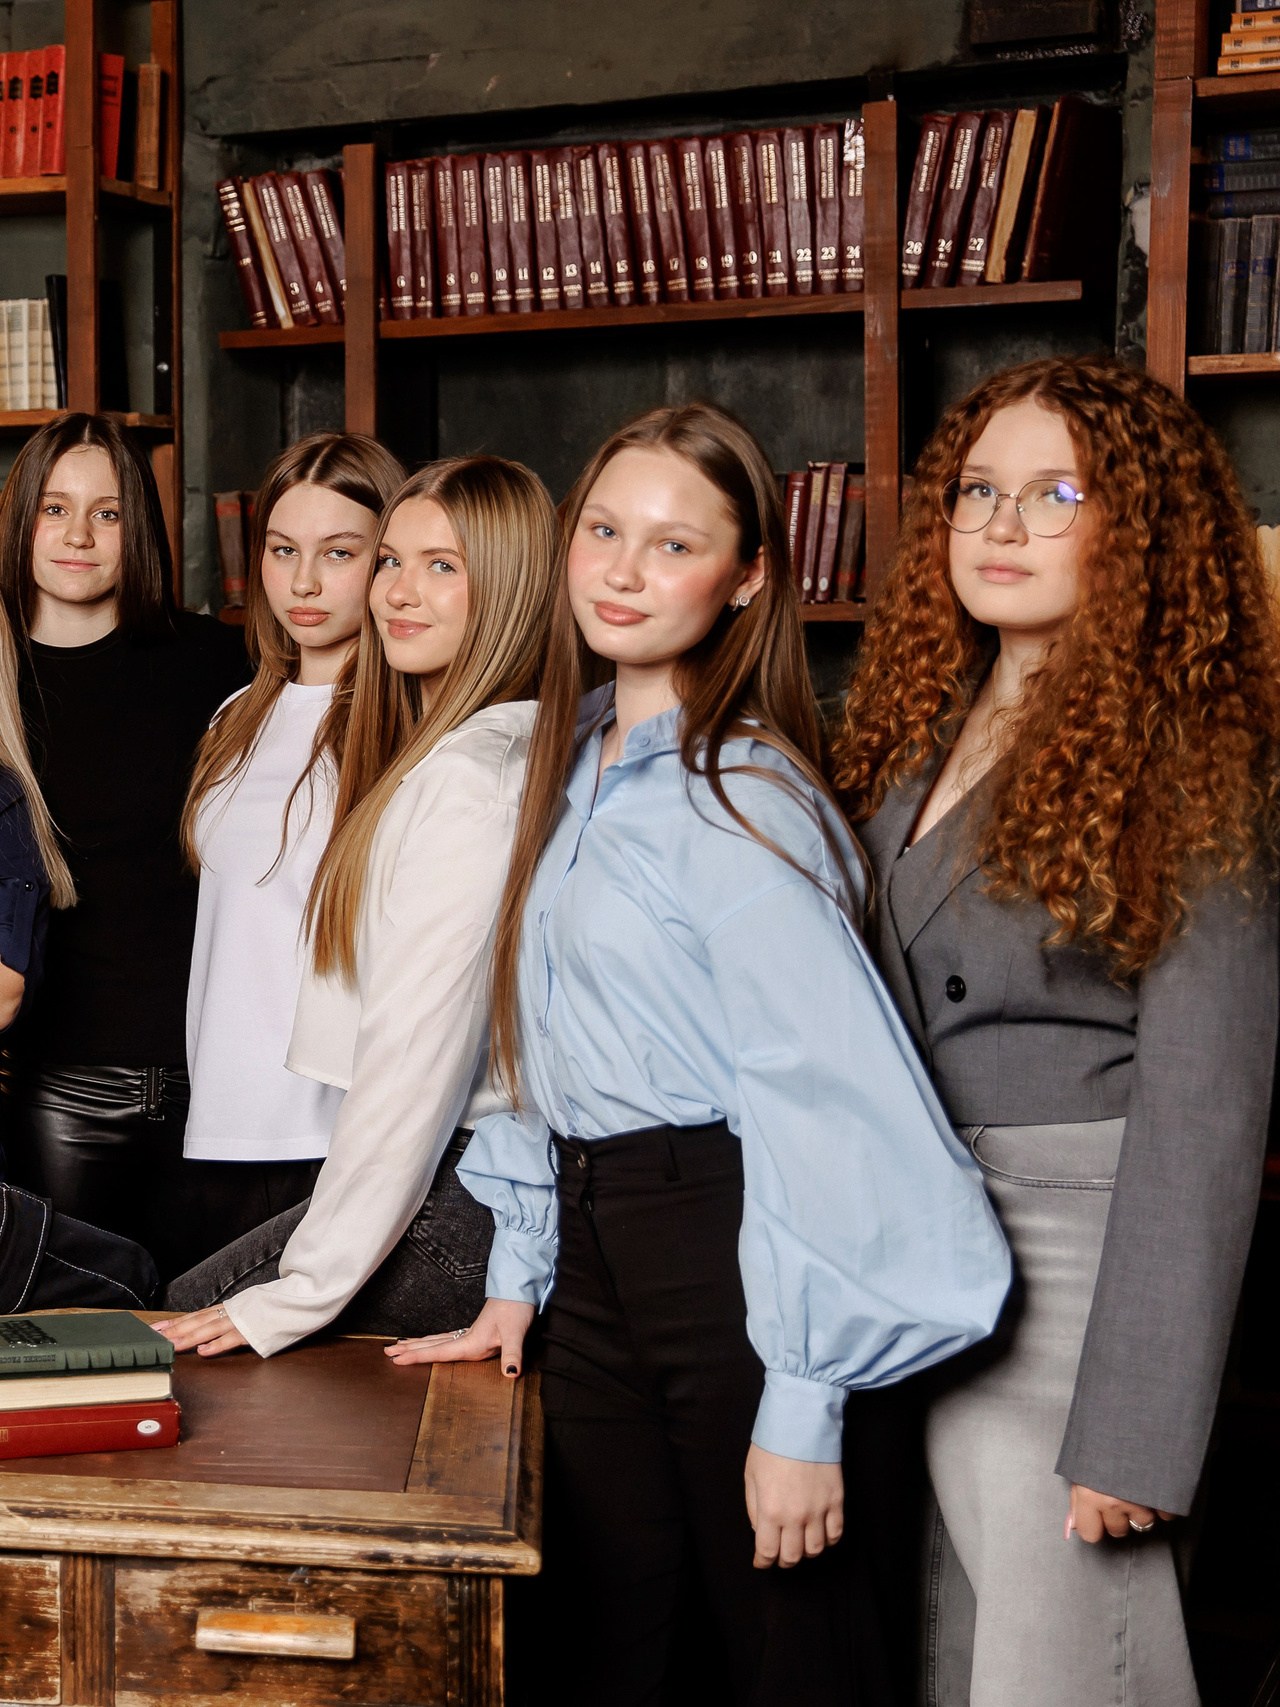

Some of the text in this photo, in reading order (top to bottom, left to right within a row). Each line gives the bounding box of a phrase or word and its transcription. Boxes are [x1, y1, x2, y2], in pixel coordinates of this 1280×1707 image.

[846, 245, 861, 259] 24
[968, 237, 985, 252] 27
[742, 250, 758, 265] 20
[768, 249, 783, 264] 21
[796, 247, 813, 262] 22
[820, 245, 837, 260] 23
[589, 260, 602, 275] 14
[616, 259, 629, 274] 15
[642, 259, 655, 274] 16
[669, 257, 679, 271] 17
[695, 256, 710, 271] 18
[721, 254, 734, 268] 19
[469, 271, 479, 285] 9
[495, 268, 508, 282] 10
[517, 266, 529, 281] 11
[542, 266, 555, 281] 12
[564, 263, 578, 278] 13
[396, 275, 406, 289] 6
[446, 272, 457, 287] 8
[289, 281, 300, 296] 3
[315, 281, 324, 294] 4
